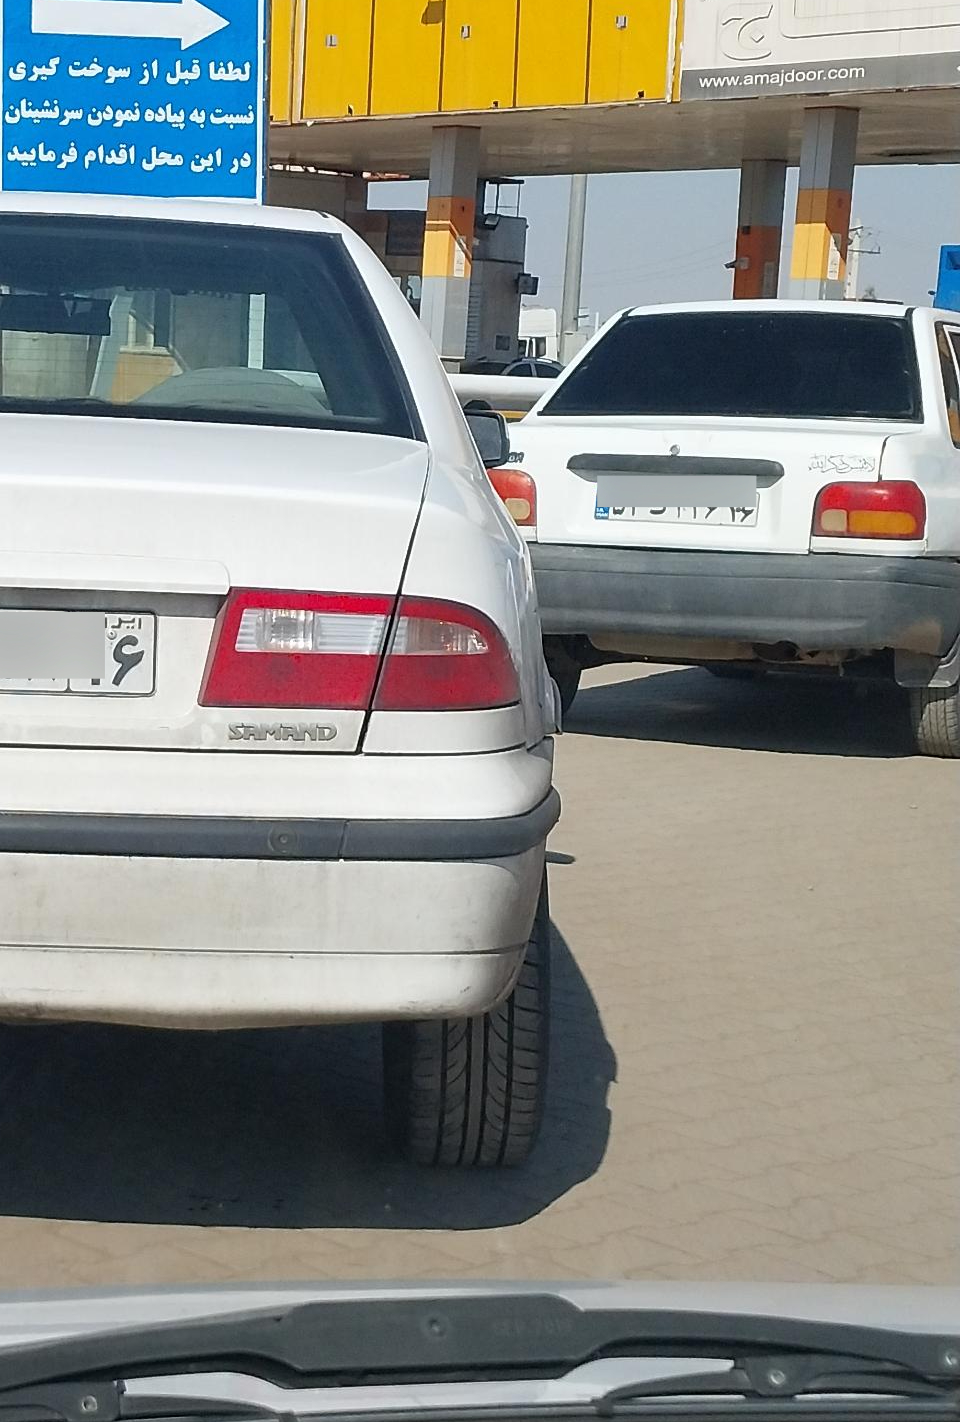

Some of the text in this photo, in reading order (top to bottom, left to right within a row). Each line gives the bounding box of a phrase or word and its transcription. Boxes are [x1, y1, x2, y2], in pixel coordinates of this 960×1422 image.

[8, 56, 251, 85] لطفا قبل از سوخت گیری
[698, 66, 866, 88] www.amajdoor.com
[4, 98, 255, 130] نسبت به پیاده نمودن سرنشینان
[7, 141, 252, 174] در این محل اقدام فرمایید
[104, 616, 142, 630] ایرا
[227, 723, 338, 742] SAMAND
